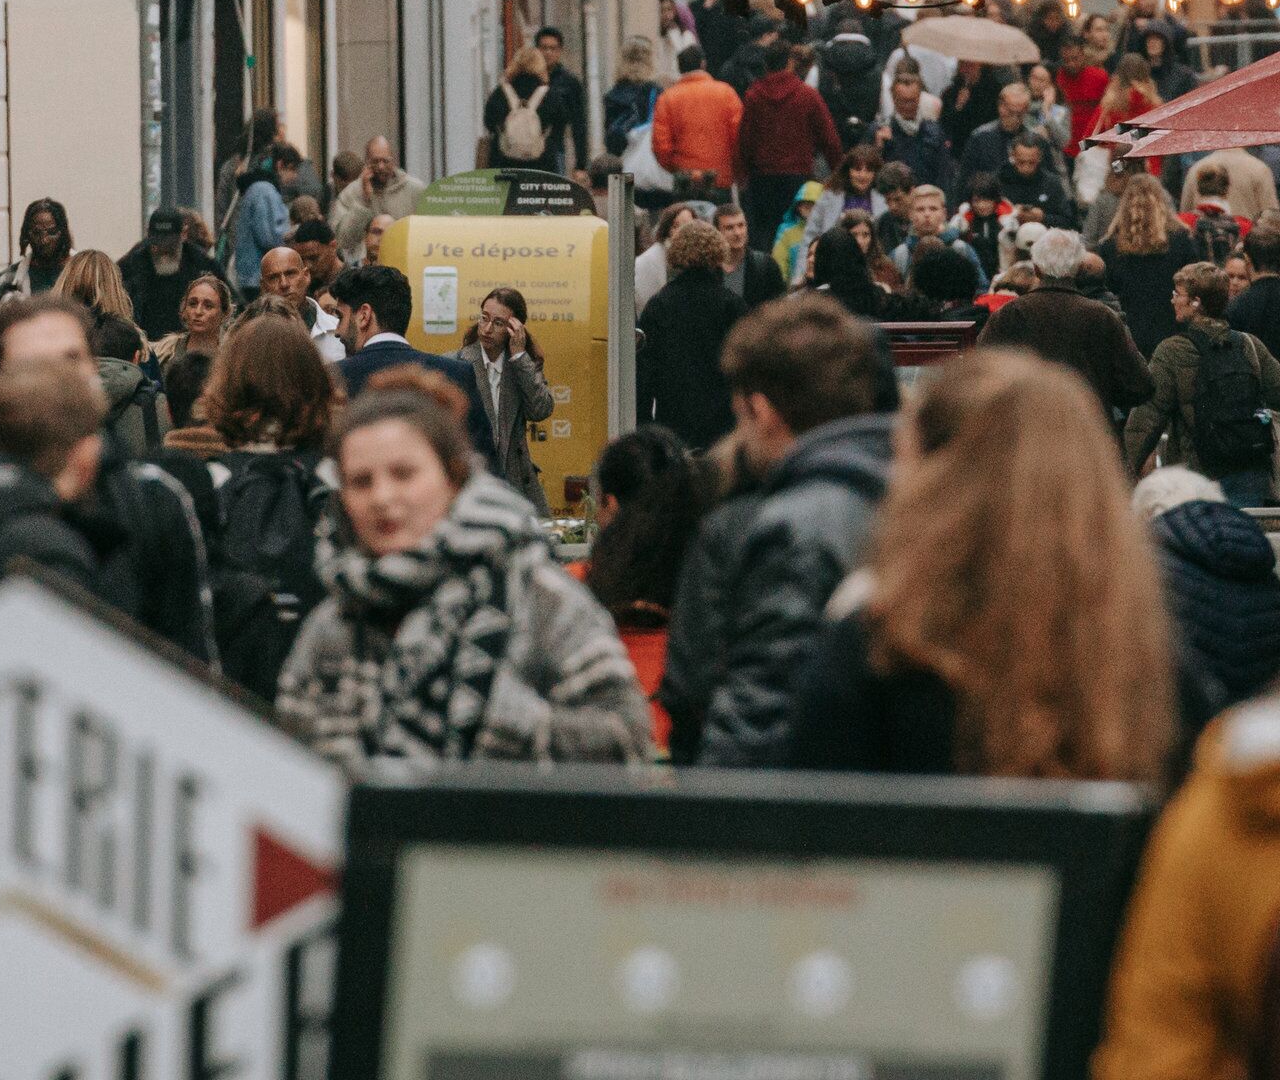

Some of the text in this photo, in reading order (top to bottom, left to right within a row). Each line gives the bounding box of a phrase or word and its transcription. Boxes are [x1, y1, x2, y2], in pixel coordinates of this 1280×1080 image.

[520, 183, 572, 191] CITY TOURS
[517, 197, 574, 206] SHORT RIDES
[471, 242, 560, 261] dépose
[566, 243, 576, 258] ?
[530, 280, 569, 288] course
